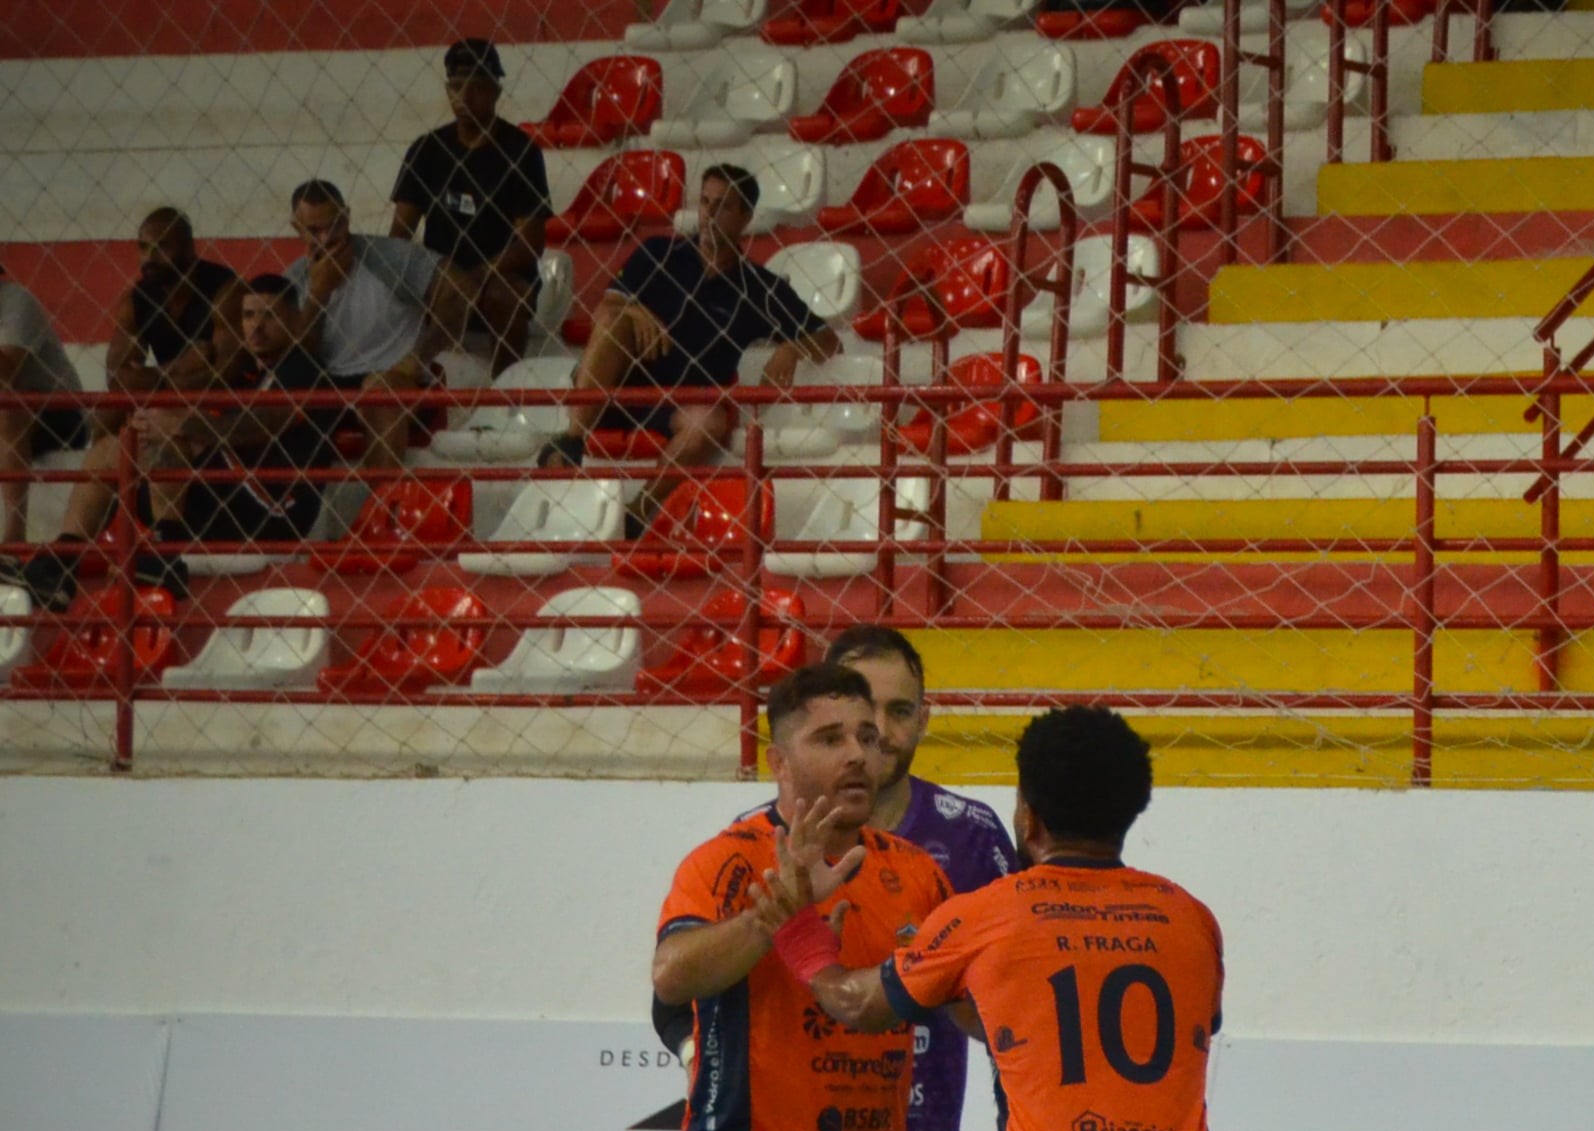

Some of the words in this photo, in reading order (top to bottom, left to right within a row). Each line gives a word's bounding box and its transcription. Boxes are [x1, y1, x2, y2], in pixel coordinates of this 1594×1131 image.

[1056, 935, 1078, 951] R.
[1084, 935, 1158, 953] FRAGA
[1047, 962, 1176, 1087] 10
[600, 1050, 687, 1068] DESD
